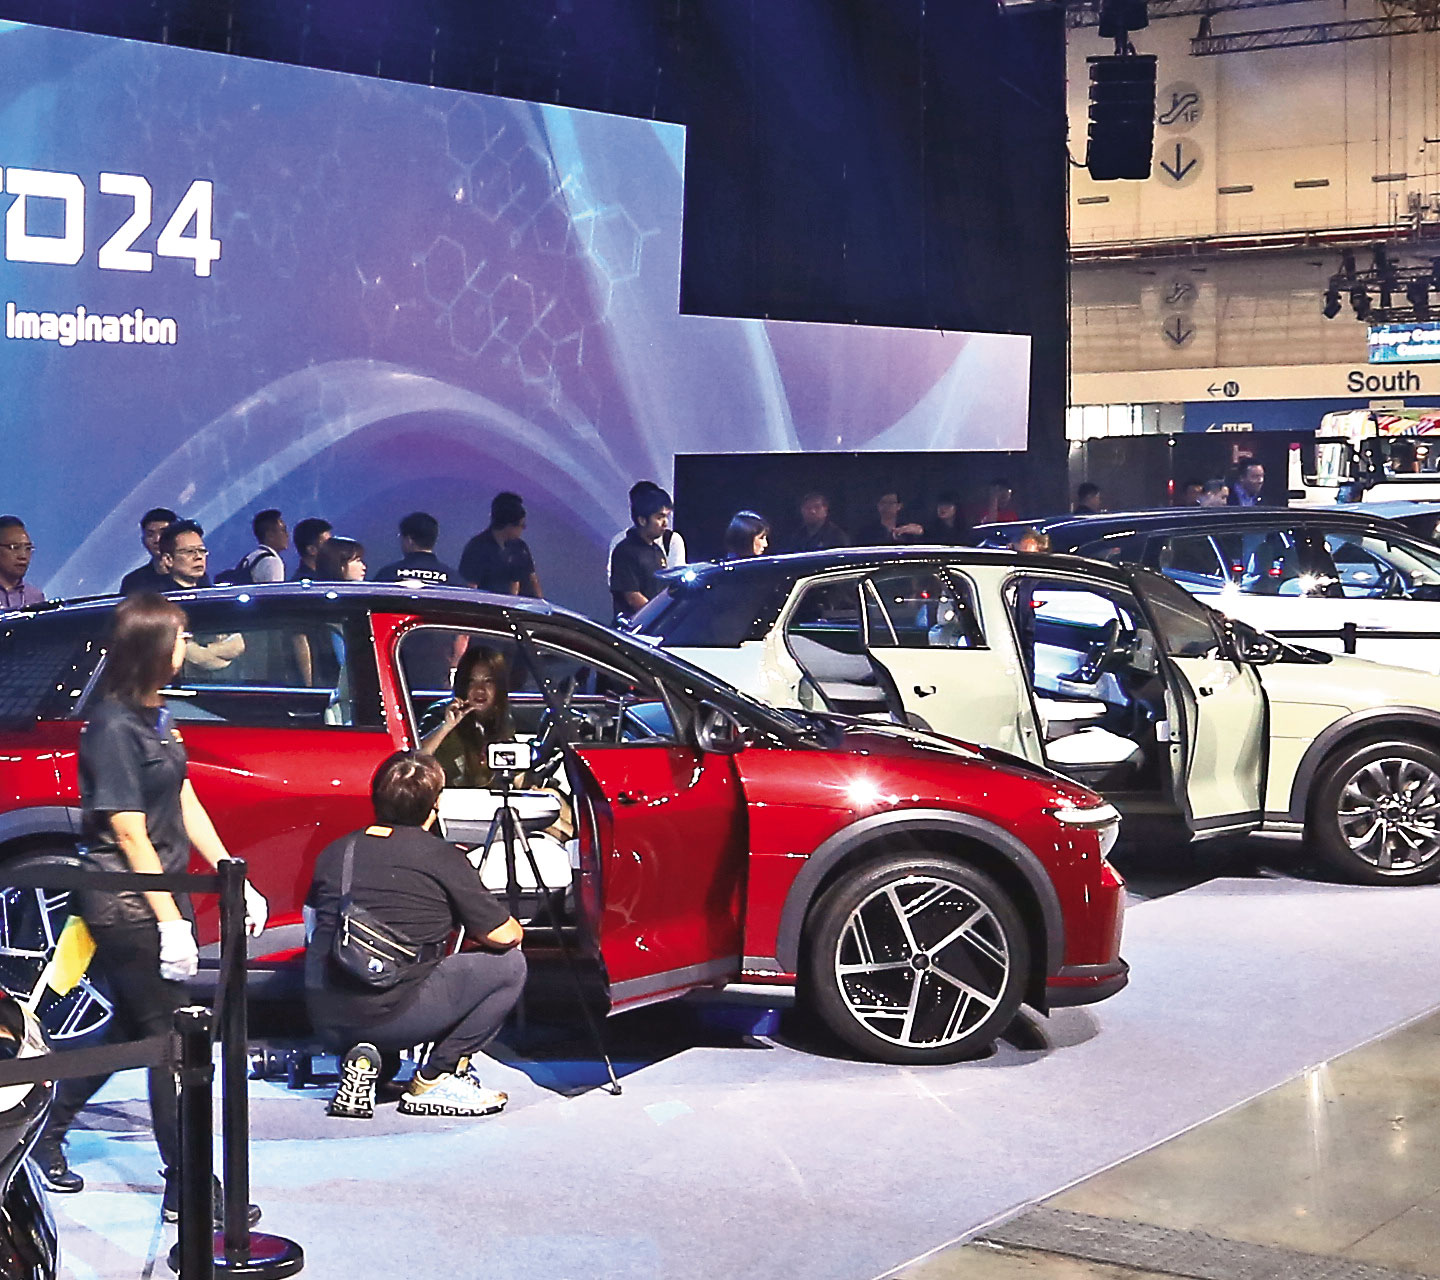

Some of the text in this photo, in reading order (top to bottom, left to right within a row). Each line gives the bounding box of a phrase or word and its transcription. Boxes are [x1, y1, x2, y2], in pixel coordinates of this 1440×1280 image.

[1182, 110, 1199, 122] 1F
[5, 302, 178, 347] Imagination
[1347, 370, 1421, 393] South
